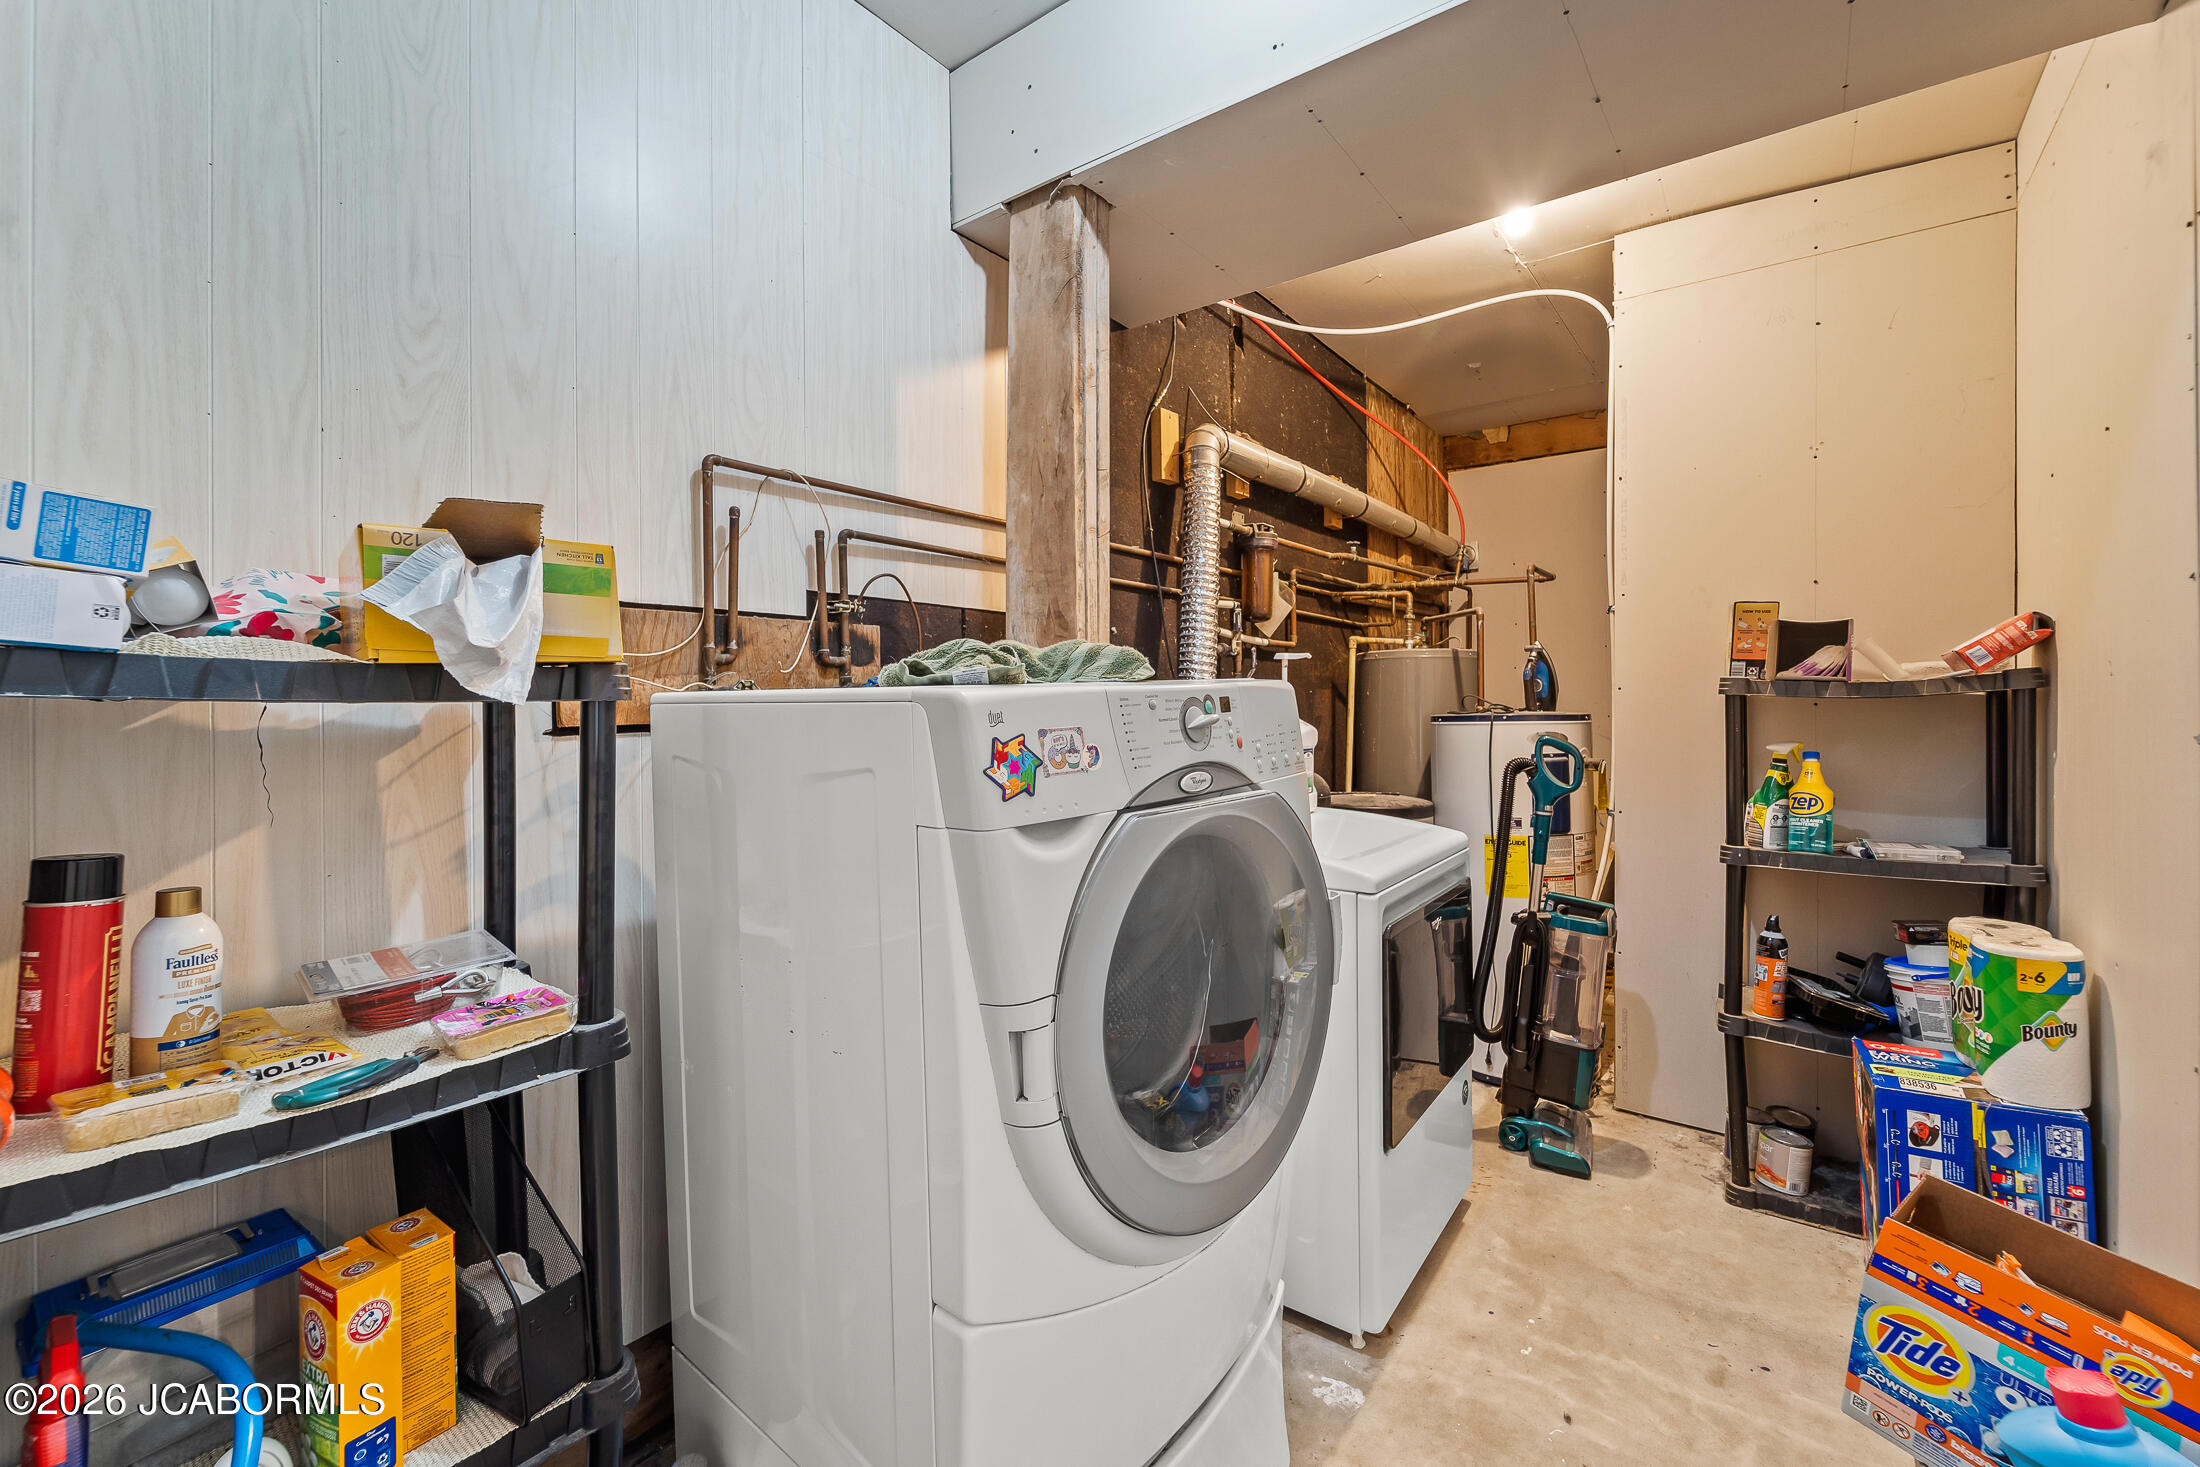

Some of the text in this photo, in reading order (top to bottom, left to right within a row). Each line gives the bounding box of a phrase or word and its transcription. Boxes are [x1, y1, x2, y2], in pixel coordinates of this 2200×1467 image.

[391, 530, 422, 546] 120
[166, 952, 219, 971] Faultless
[175, 964, 215, 978] PREMIUM
[177, 979, 194, 990] LUXE
[2021, 1022, 2078, 1042] Bounty
[246, 1052, 347, 1082] VICTOR
[1899, 1077, 1938, 1091] 838536
[365, 1301, 390, 1318] HAMMER
[1967, 1301, 1982, 1317] 2
[1875, 1316, 1962, 1378] Tide
[2000, 1371, 2055, 1407] ULTR
[2109, 1363, 2163, 1400] Tide
